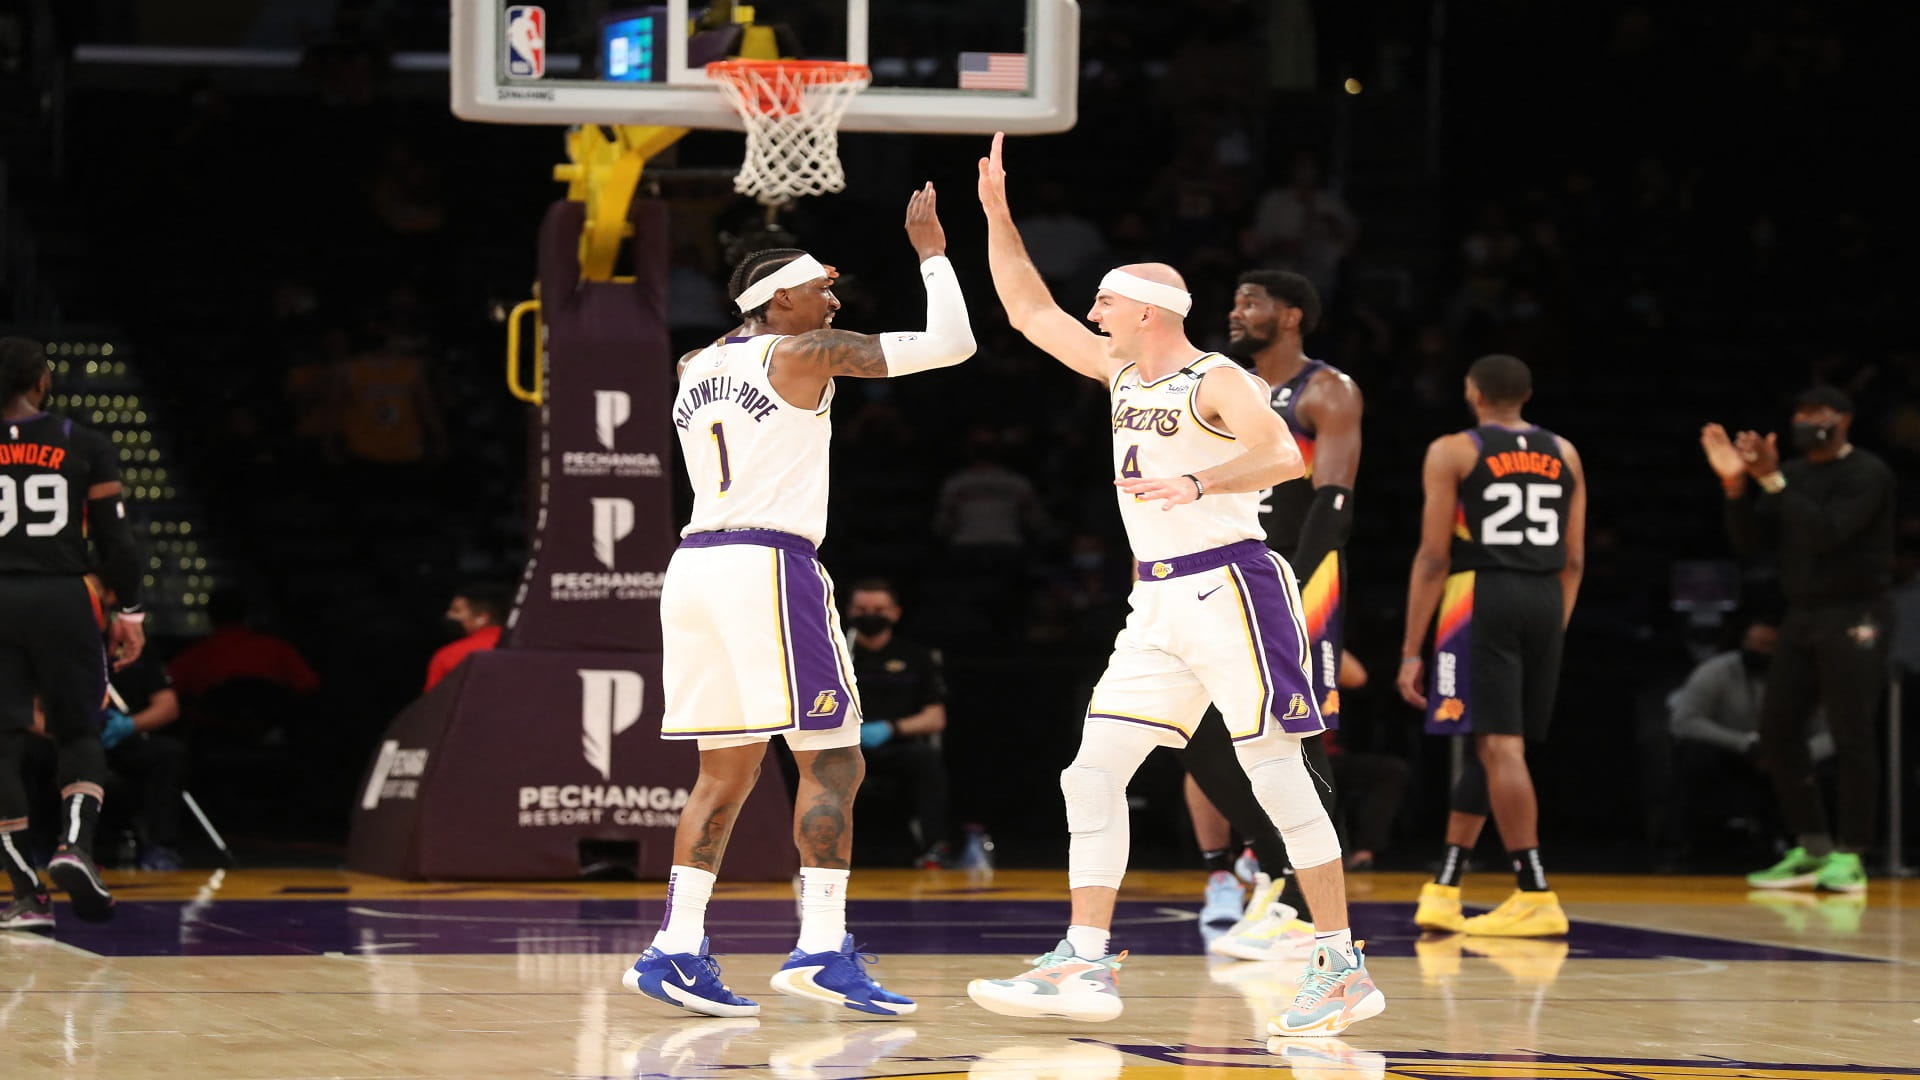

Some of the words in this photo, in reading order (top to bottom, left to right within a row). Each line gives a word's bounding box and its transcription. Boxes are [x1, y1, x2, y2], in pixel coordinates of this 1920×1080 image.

[676, 376, 778, 432] CALDWELL-POPE
[0, 443, 65, 470] OWDER
[562, 451, 661, 467] PECHANGA
[710, 421, 732, 497] 1
[1485, 451, 1562, 480] BRIDGES
[562, 466, 610, 475] RESORT
[1481, 482, 1563, 546] 25
[550, 589, 610, 599] RESORT
[615, 588, 661, 599] CASIN
[518, 785, 690, 811] PECHANGA
[518, 808, 604, 826] RESORT
[612, 808, 679, 827] CASIN
